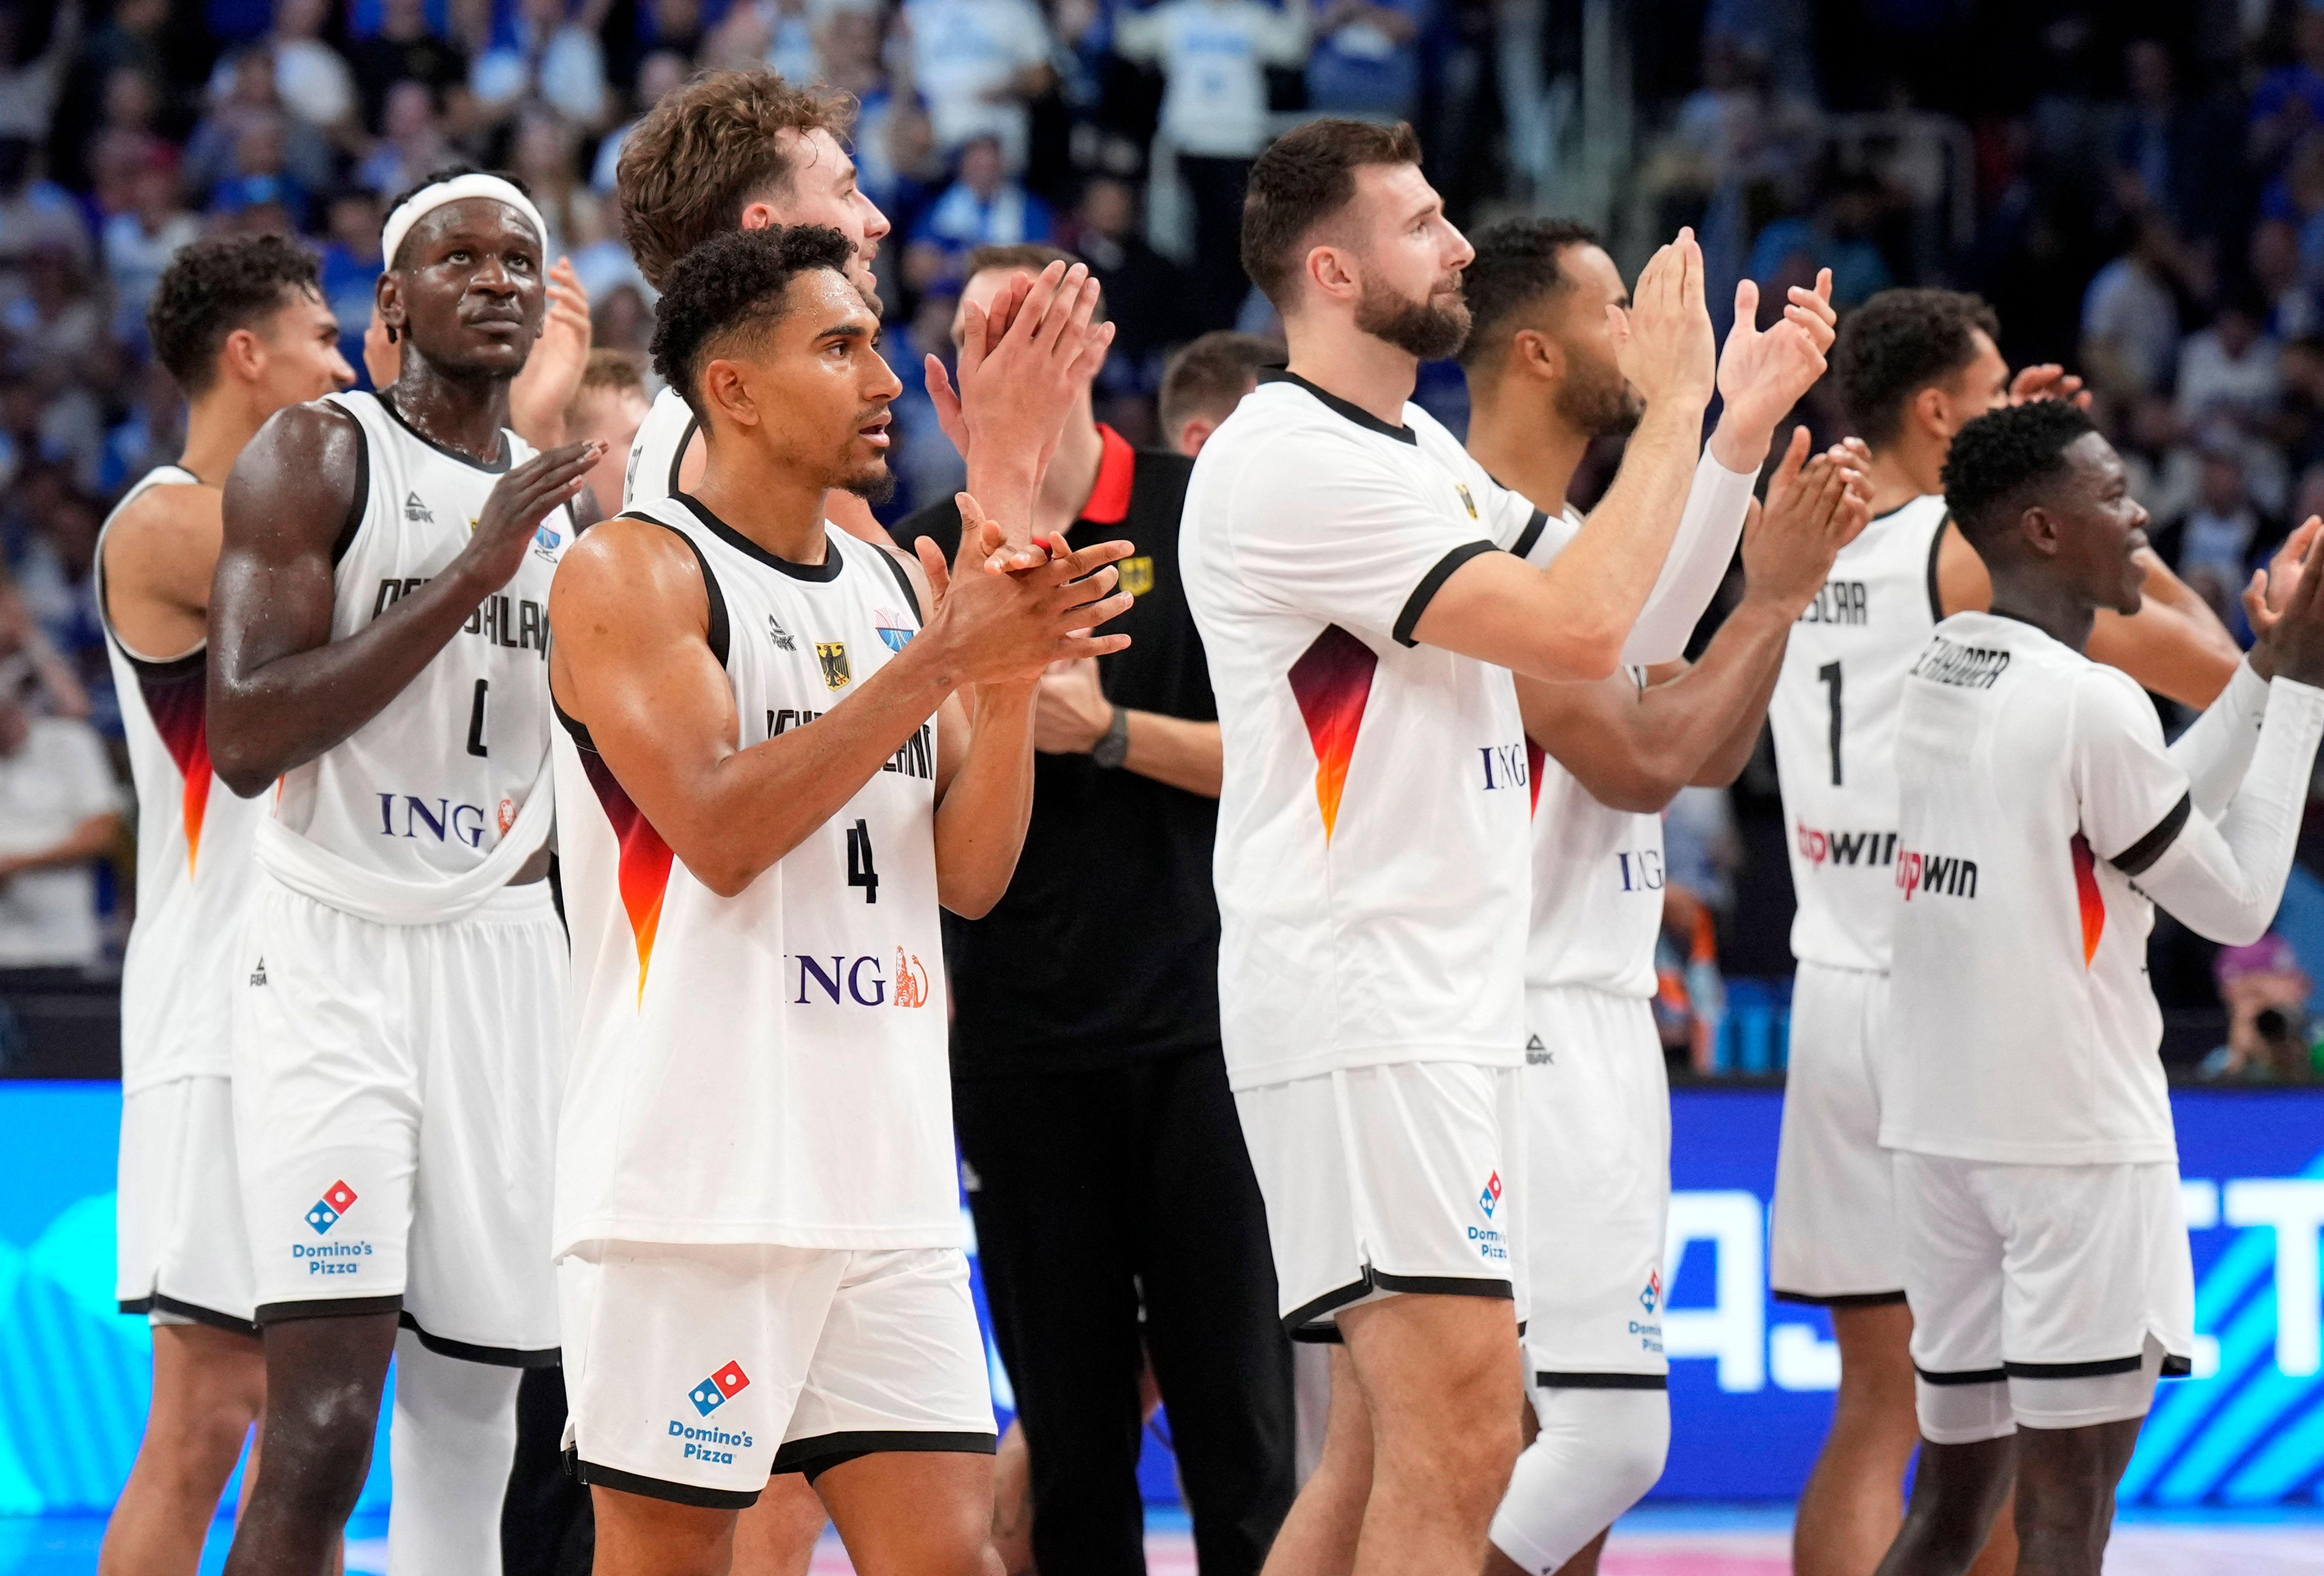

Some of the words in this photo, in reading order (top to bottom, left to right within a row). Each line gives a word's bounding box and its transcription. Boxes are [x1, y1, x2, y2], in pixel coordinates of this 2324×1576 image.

[1820, 660, 1841, 786] 1
[1478, 743, 1525, 790] ING
[376, 793, 485, 848] ING
[847, 818, 878, 903] 4
[1618, 850, 1663, 891] ING
[250, 972, 267, 987] PEA
[784, 954, 886, 1006] NG
[293, 1241, 372, 1258] Domino's
[310, 1260, 357, 1274] Pizza
[669, 1420, 753, 1447] Domino's
[684, 1443, 733, 1464] Pizza
